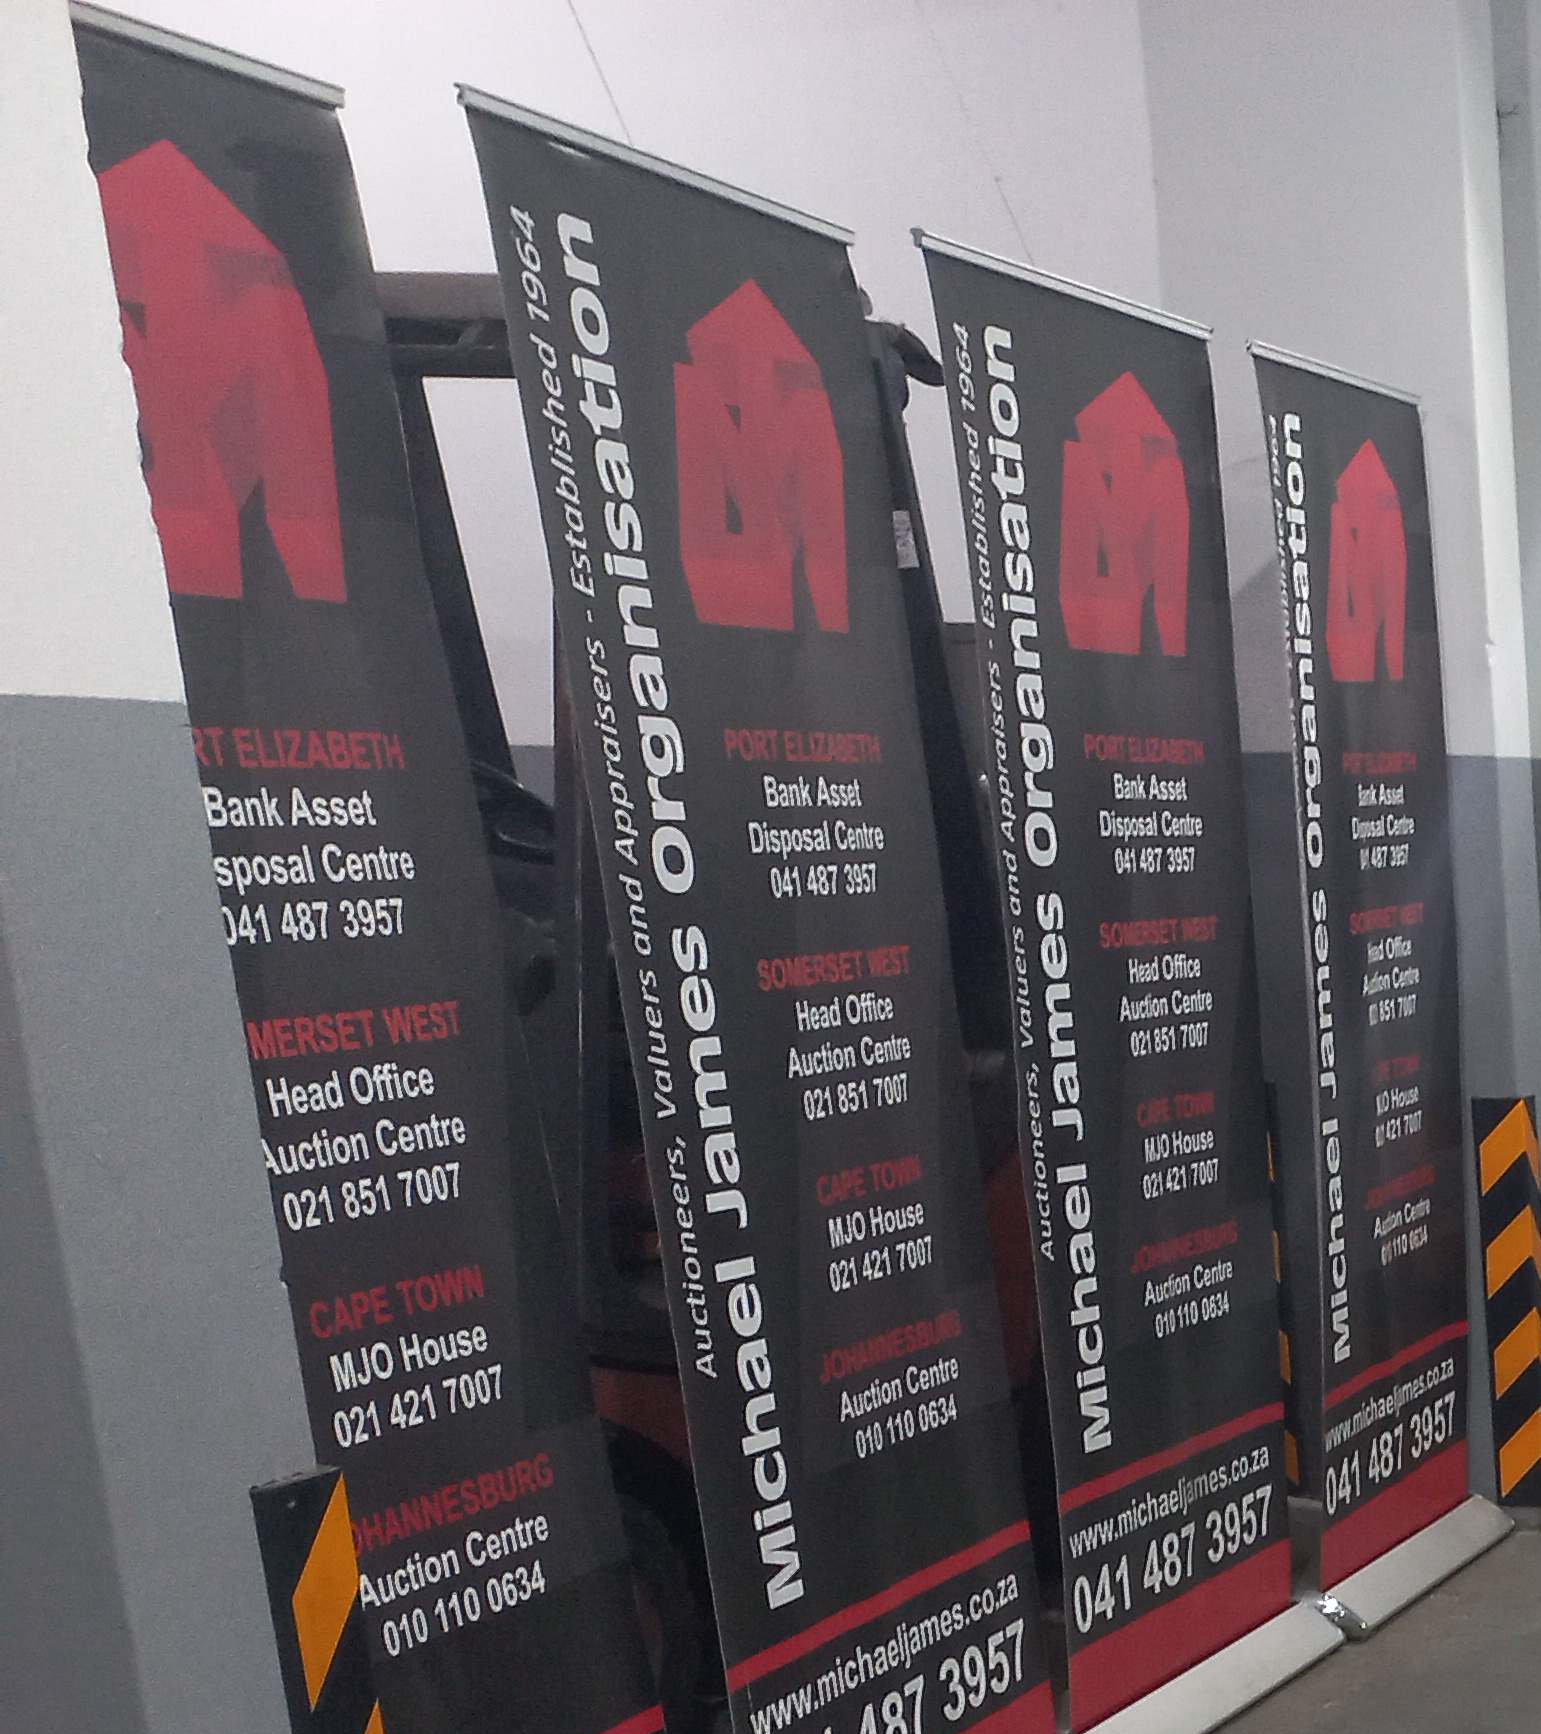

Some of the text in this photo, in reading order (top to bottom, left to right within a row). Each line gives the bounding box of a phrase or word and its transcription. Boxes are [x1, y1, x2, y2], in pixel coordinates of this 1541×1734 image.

[1283, 413, 1323, 868] Organisation
[232, 727, 405, 769] ELIZABETH
[725, 728, 881, 763] PORT ELIZABETH
[202, 786, 377, 827] Bank Asset
[509, 204, 718, 1378] Auctioneers, Valuers and Appraisers Established 1964
[763, 776, 862, 808] Bank Asset
[953, 321, 1055, 1261] Auctioneers, Valuers and Appraisers Established 1964
[1113, 773, 1187, 800] Bank Asset
[748, 820, 884, 860] Disposal Centre
[1100, 810, 1203, 841] Disposal Centre
[213, 843, 416, 896] sposal Centre
[770, 863, 877, 898] 041 487 3957
[1114, 847, 1195, 874] 041 487 3957
[557, 211, 806, 1609] Michael James Organisation
[982, 324, 1112, 1453] Michael James Organisation
[281, 901, 328, 942] 487
[339, 898, 403, 938] 3957
[757, 945, 909, 991] SOMERSET WEST
[1129, 954, 1200, 983] Head Office
[1312, 889, 1336, 1099] James
[247, 1001, 460, 1060] MERSET WEST
[796, 992, 894, 1032] Head Office
[1120, 989, 1213, 1021] Auction Centre
[787, 1034, 910, 1078] Auction Centre
[1130, 1022, 1208, 1057] 021 851 7007
[265, 1063, 434, 1118] Head Office
[804, 1073, 908, 1121] 021 851 7007
[1392, 1086, 1419, 1109] House
[261, 1114, 466, 1175] Auction Centre
[1144, 1130, 1214, 1163] MJO House
[283, 1162, 460, 1231] 021 851 7007
[817, 1154, 921, 1207] CAPE TOWN
[1142, 1158, 1219, 1199] 021 421 7007
[828, 1202, 924, 1249] MJO House
[1320, 1118, 1351, 1363] Michael
[829, 1235, 932, 1292] 021 421 7007
[1144, 1259, 1233, 1307] Auction Centre
[310, 1265, 484, 1339] CAPE TOWN
[1155, 1290, 1230, 1339] 010 110 0634
[329, 1325, 489, 1392] MJO House
[334, 1365, 503, 1448] 021 421 7007
[840, 1357, 959, 1422] Auction Centre
[1324, 1356, 1455, 1451] www.michaeljames.co.za
[855, 1394, 957, 1458] 010 110 0634
[1325, 1391, 1456, 1515] 041 487 3957
[351, 1452, 554, 1555] OHANNESBURG
[1069, 1445, 1269, 1558] www.michaeljames.co.za
[359, 1513, 548, 1610] Auction Centre
[1073, 1484, 1274, 1633] 041 487 3957
[383, 1560, 546, 1657] 010 110 0634
[939, 1619, 1026, 1721] 3957
